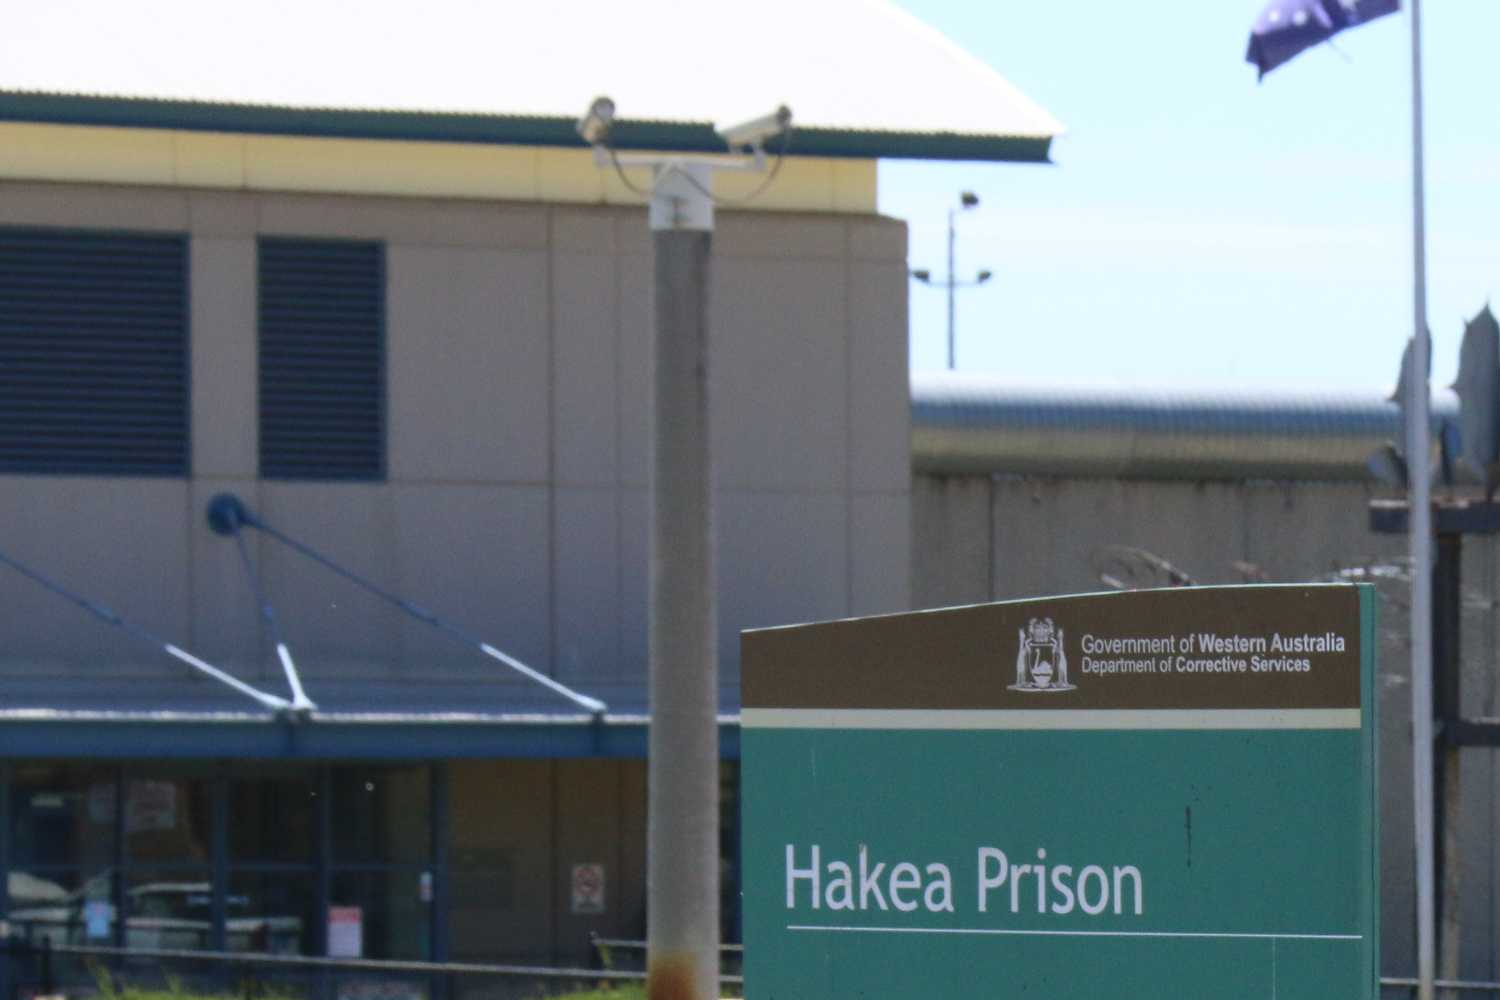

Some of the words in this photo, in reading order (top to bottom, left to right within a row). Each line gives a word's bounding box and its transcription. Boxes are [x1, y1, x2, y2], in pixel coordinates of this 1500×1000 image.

[1081, 634, 1176, 654] Government
[1179, 633, 1197, 653] of
[1199, 633, 1266, 653] Western
[1271, 632, 1346, 652] Australia
[1081, 656, 1157, 676] Department
[1159, 656, 1172, 673] of
[1175, 656, 1247, 673] Corrective
[1250, 655, 1311, 672] Services
[785, 844, 954, 913] Hakea
[977, 847, 1144, 916] Prison
